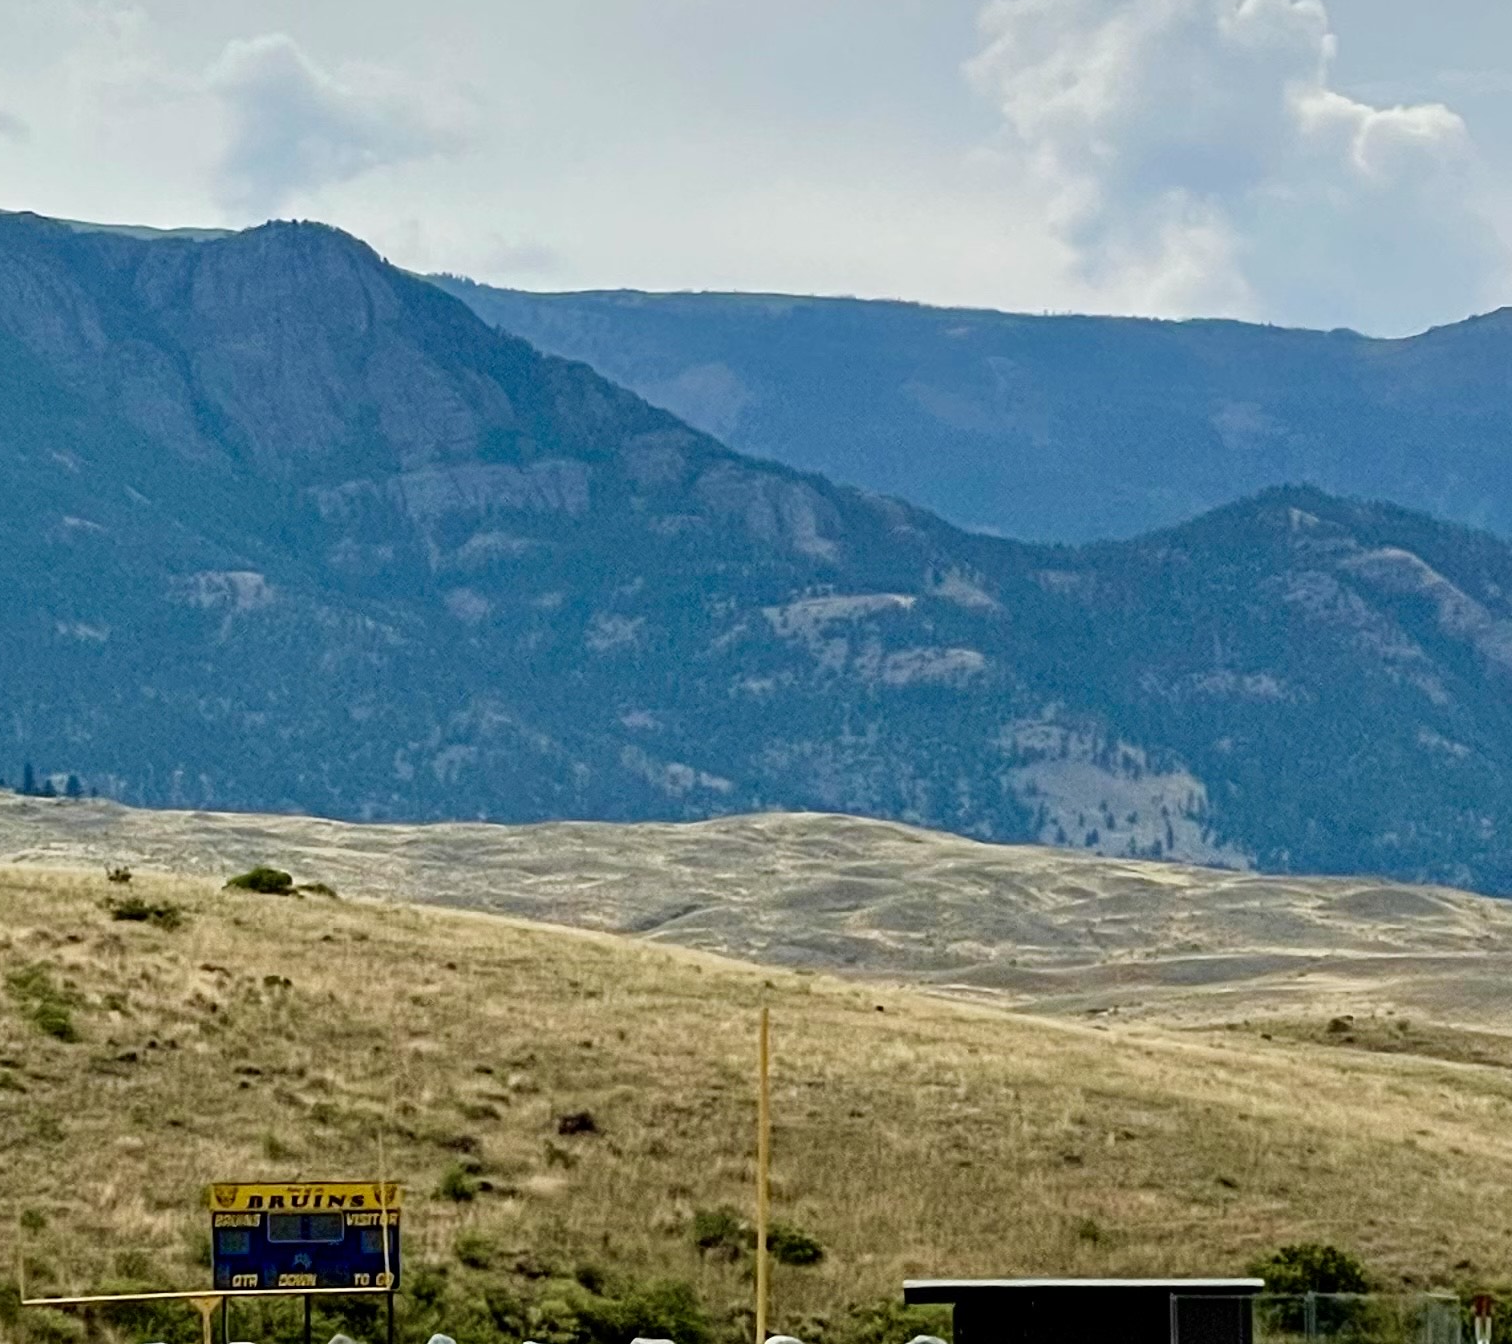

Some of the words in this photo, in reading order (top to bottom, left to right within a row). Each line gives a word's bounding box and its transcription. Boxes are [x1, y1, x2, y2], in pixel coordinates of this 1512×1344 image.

[247, 1194, 365, 1208] BRUINS
[232, 1274, 258, 1288] QTR
[278, 1273, 317, 1286] DOWN
[354, 1273, 370, 1287] TO
